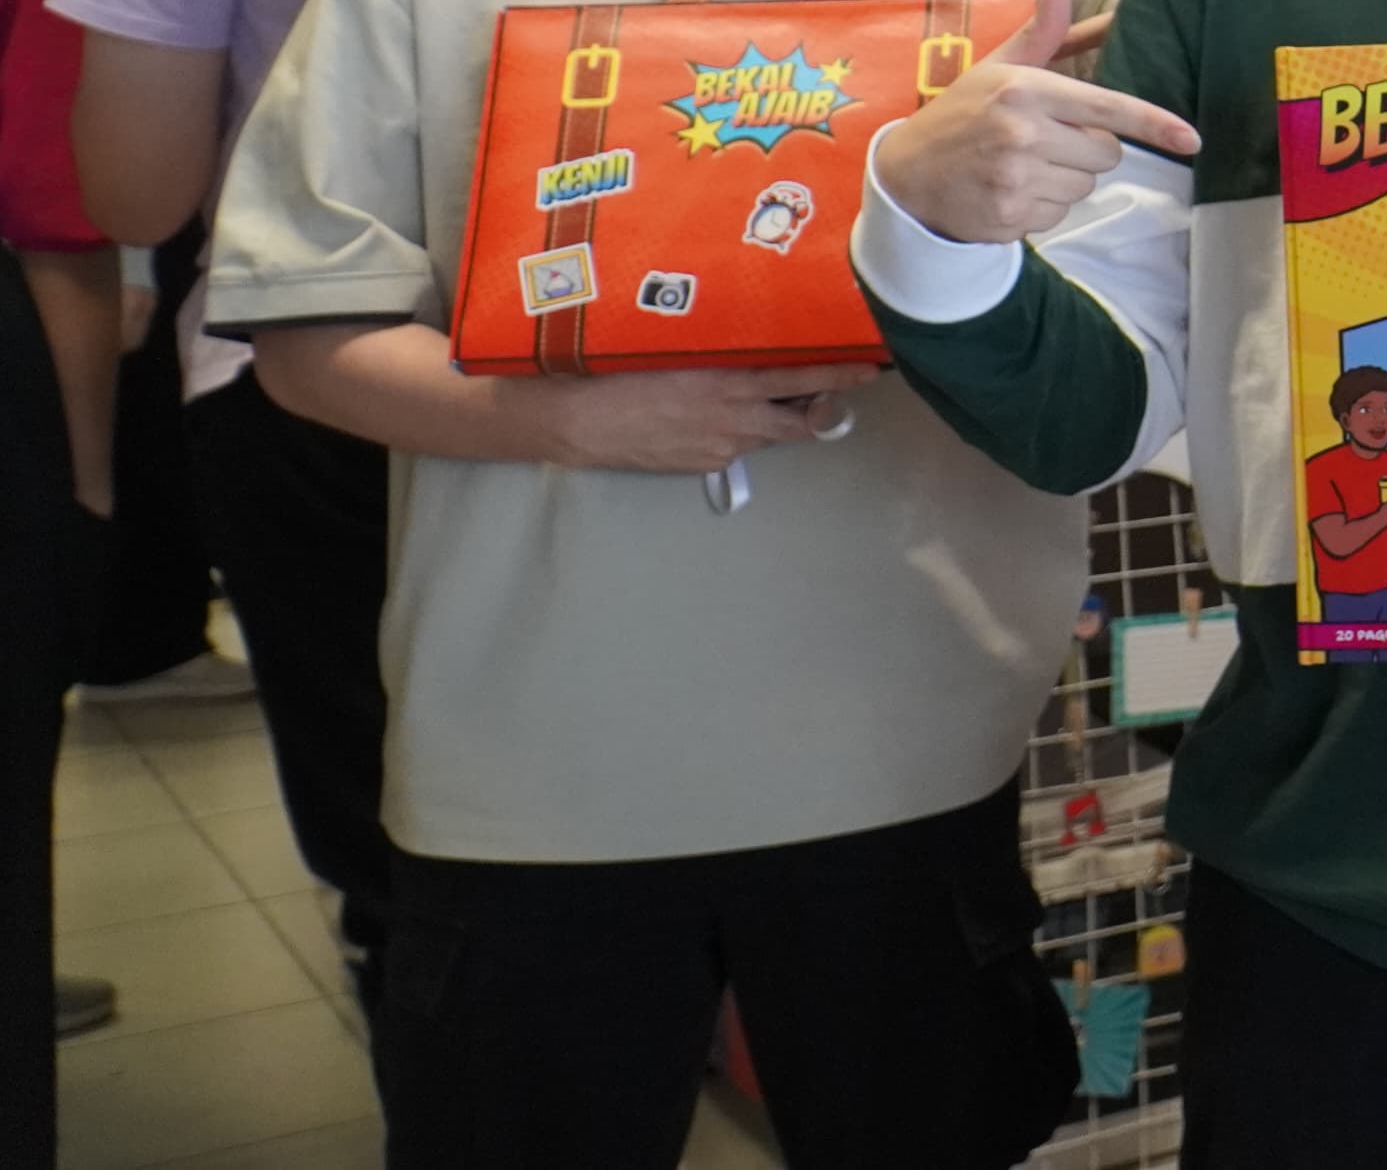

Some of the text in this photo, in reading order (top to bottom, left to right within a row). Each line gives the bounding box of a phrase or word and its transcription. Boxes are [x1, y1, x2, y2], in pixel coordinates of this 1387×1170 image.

[694, 62, 795, 108] BEKAL
[732, 90, 836, 127] AJAIB
[541, 155, 629, 205] KENJI
[1336, 629, 1353, 642] 20
